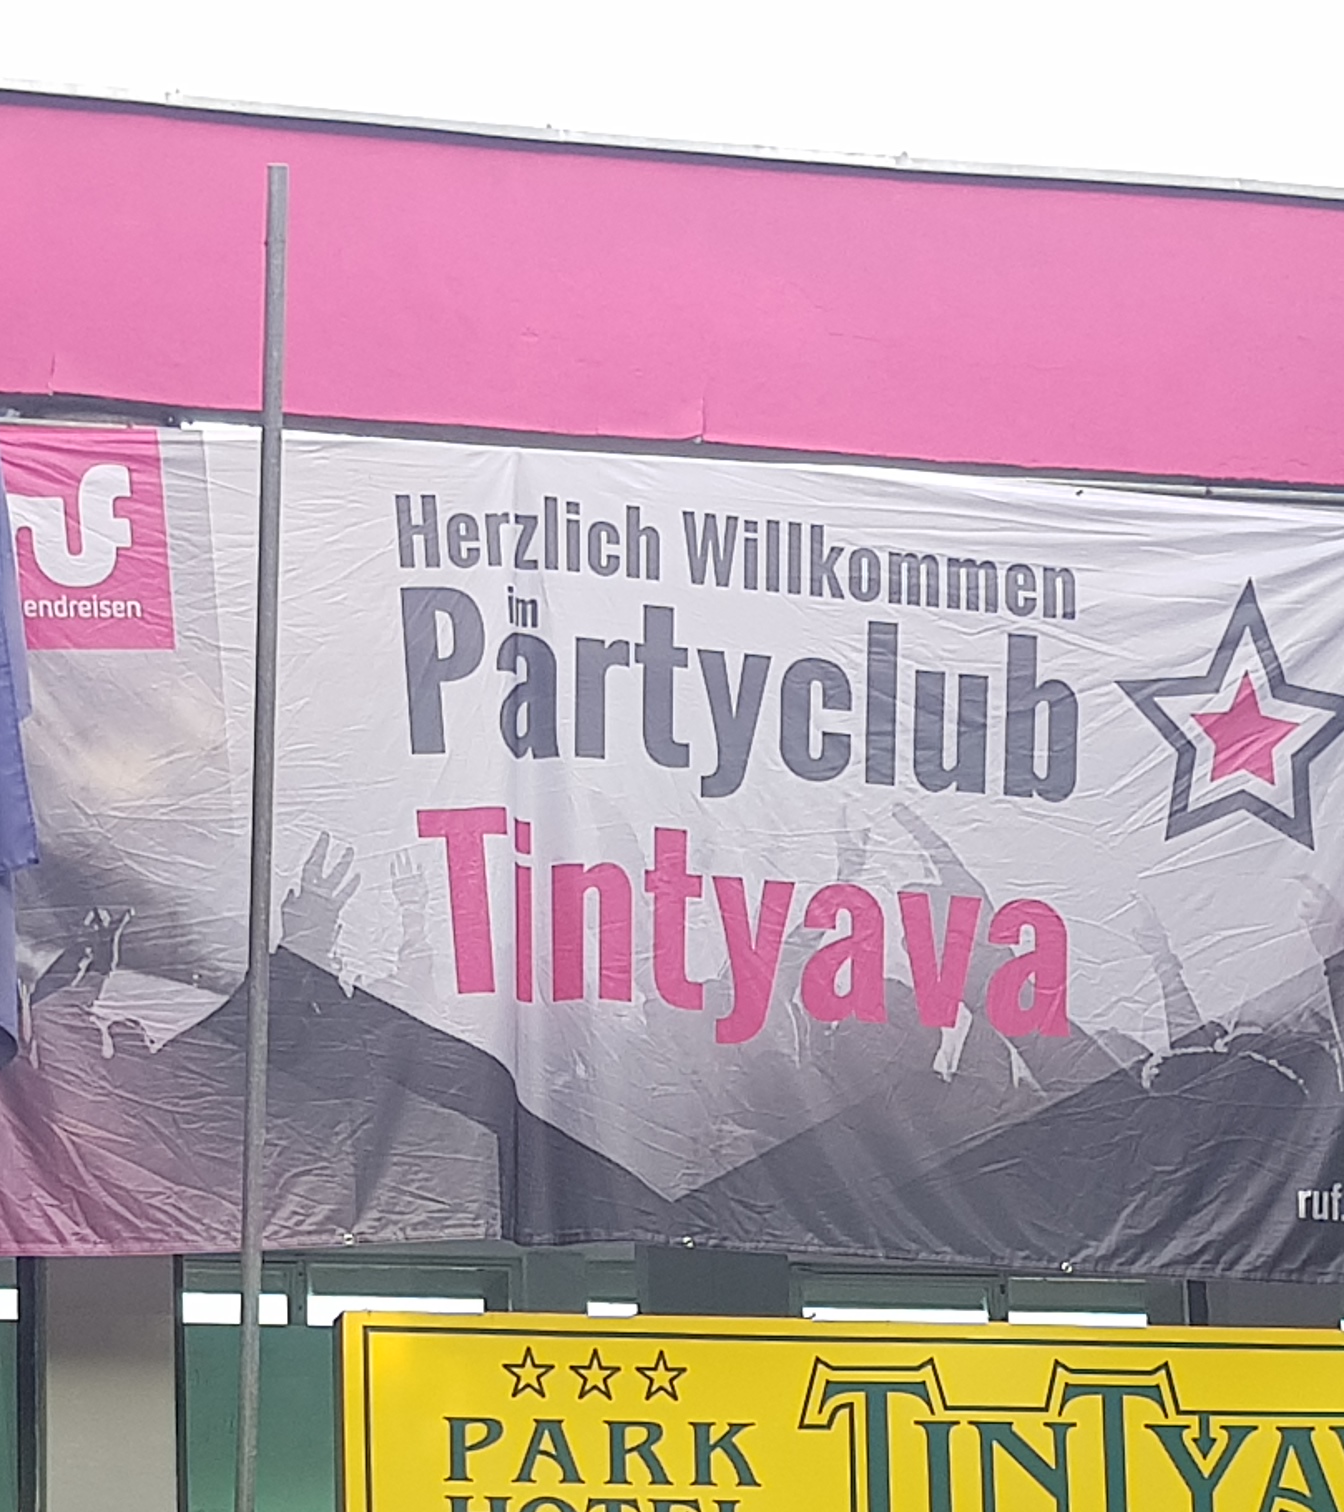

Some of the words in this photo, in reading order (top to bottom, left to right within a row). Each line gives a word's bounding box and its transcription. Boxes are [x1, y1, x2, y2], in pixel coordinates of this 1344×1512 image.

[23, 594, 142, 619] endreisen
[394, 493, 661, 580] Herzlich
[682, 510, 1078, 621] Willkommen
[507, 585, 539, 629] im
[399, 586, 1080, 803] Partyclub
[416, 806, 1071, 1044] Tintyava
[443, 1415, 762, 1488] PARK
